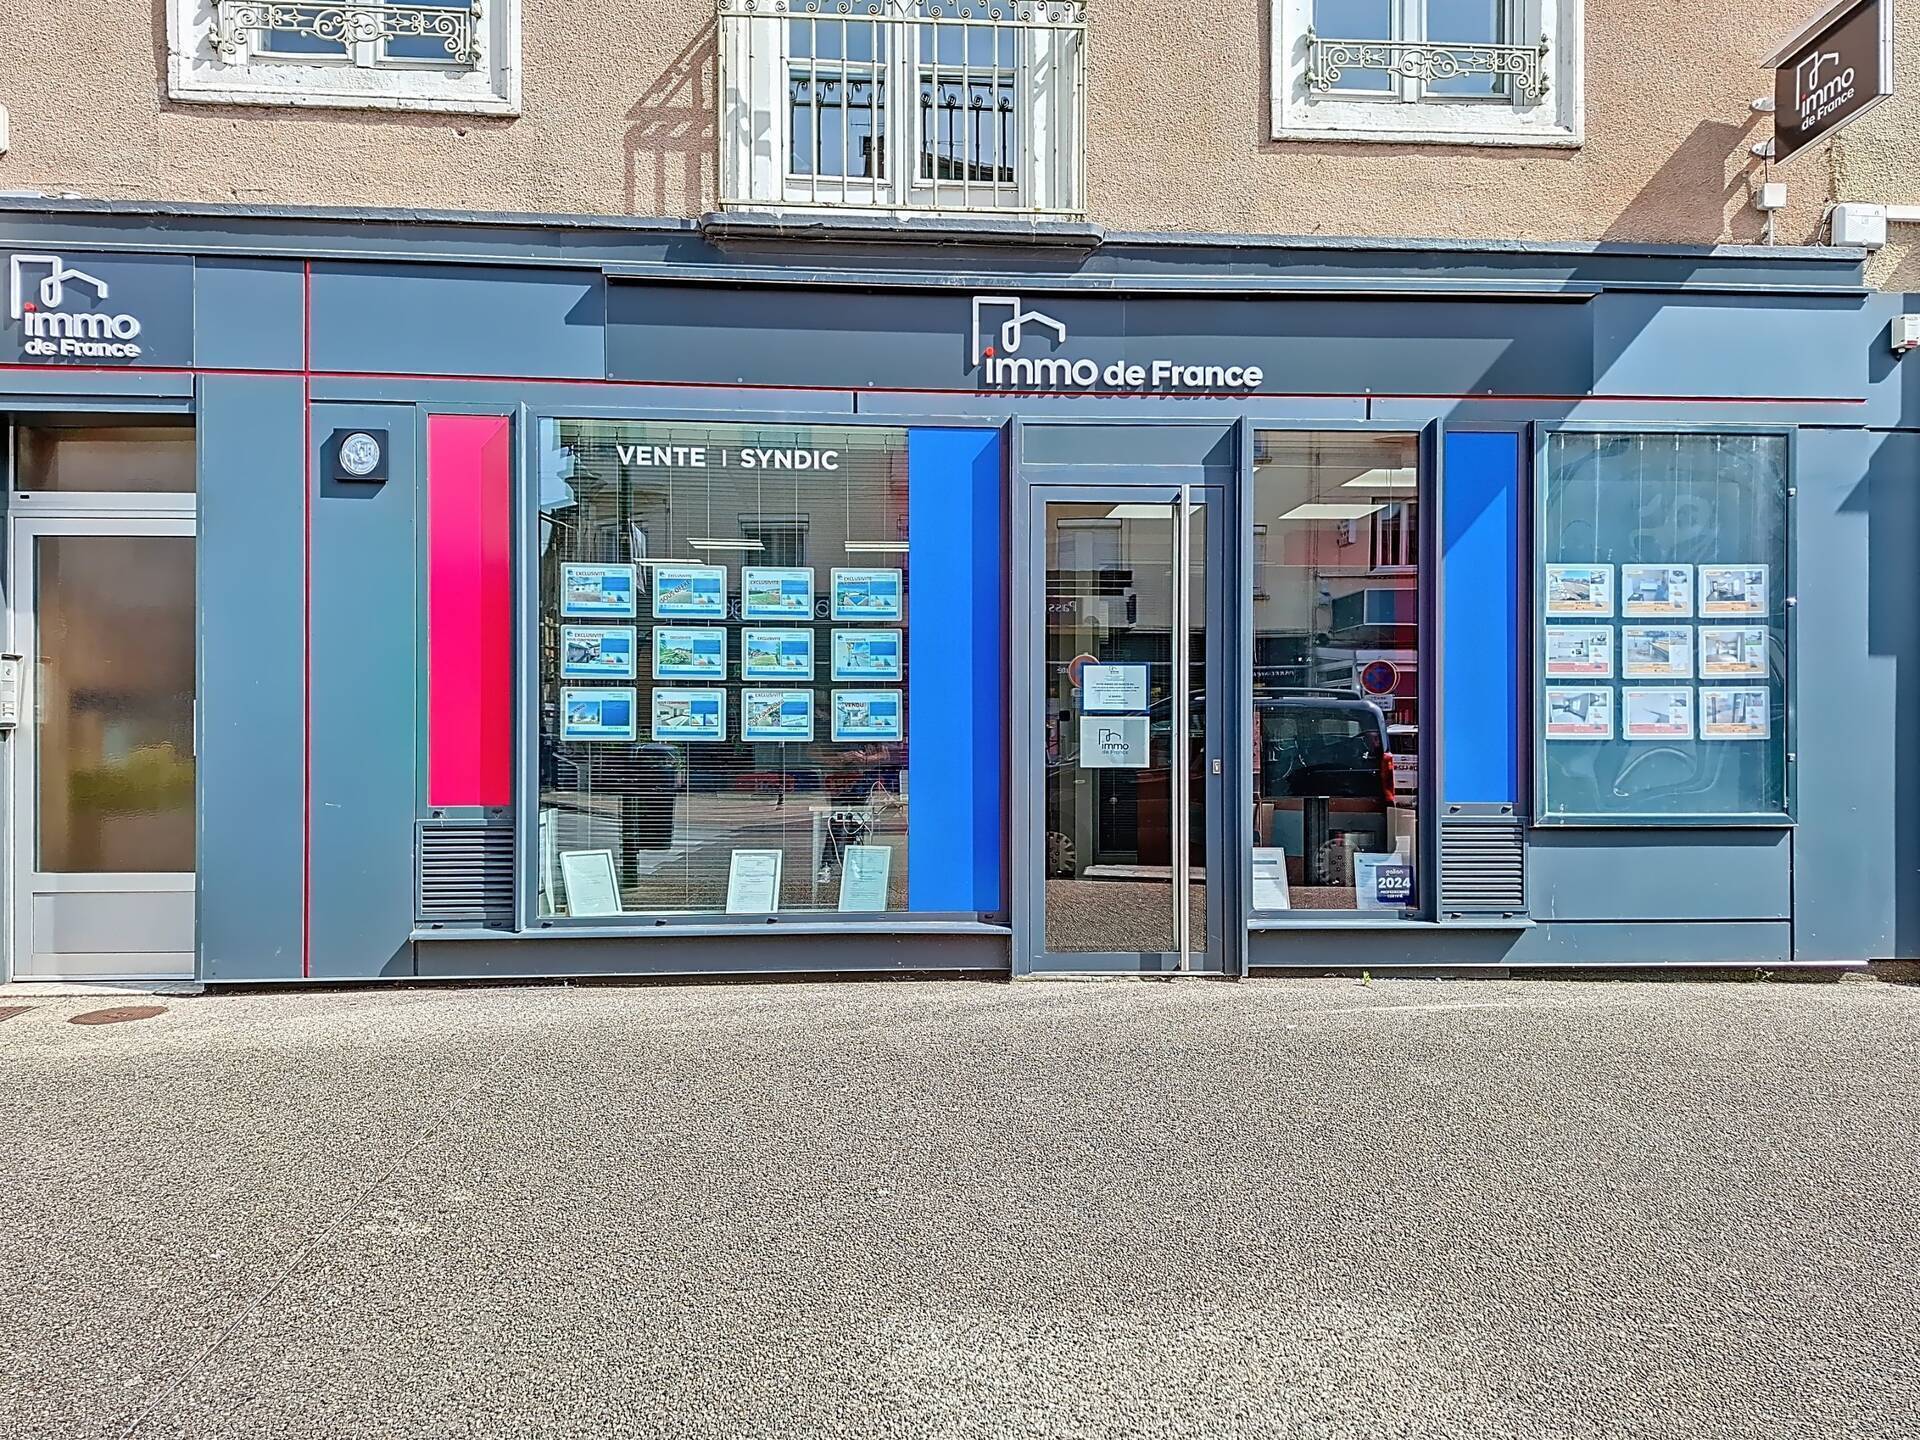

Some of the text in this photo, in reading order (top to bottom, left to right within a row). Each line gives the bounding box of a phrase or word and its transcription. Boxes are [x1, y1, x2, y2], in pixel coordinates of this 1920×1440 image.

[1801, 67, 1855, 118] immo
[1801, 87, 1855, 130] de France
[24, 302, 141, 340] immo
[24, 338, 141, 357] de France
[985, 346, 1264, 387] immo de France
[616, 445, 839, 470] VENTE SYNDIC
[1101, 742, 1129, 750] immo
[1378, 877, 1411, 889] 2024
